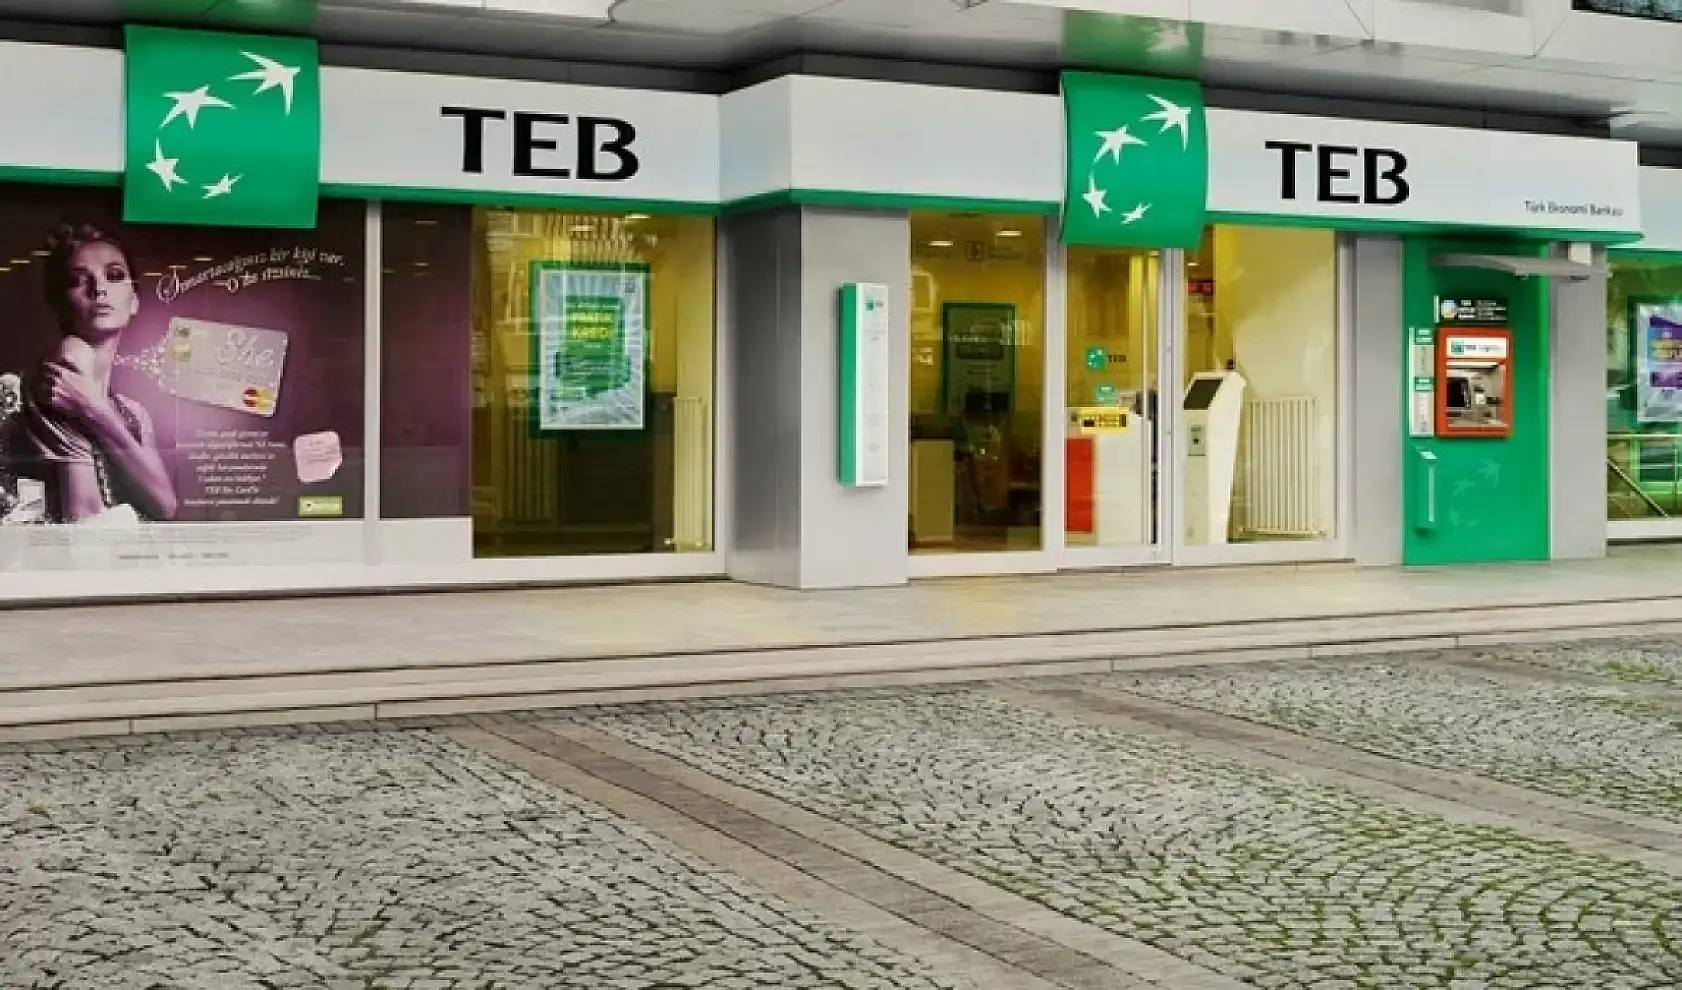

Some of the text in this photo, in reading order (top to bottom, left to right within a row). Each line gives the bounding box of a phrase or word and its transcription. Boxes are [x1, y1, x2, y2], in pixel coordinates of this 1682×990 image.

[441, 106, 639, 180] TEB
[1264, 140, 1410, 205] TEB
[1524, 200, 1545, 213] Türk
[1548, 201, 1588, 215] Ekonomi
